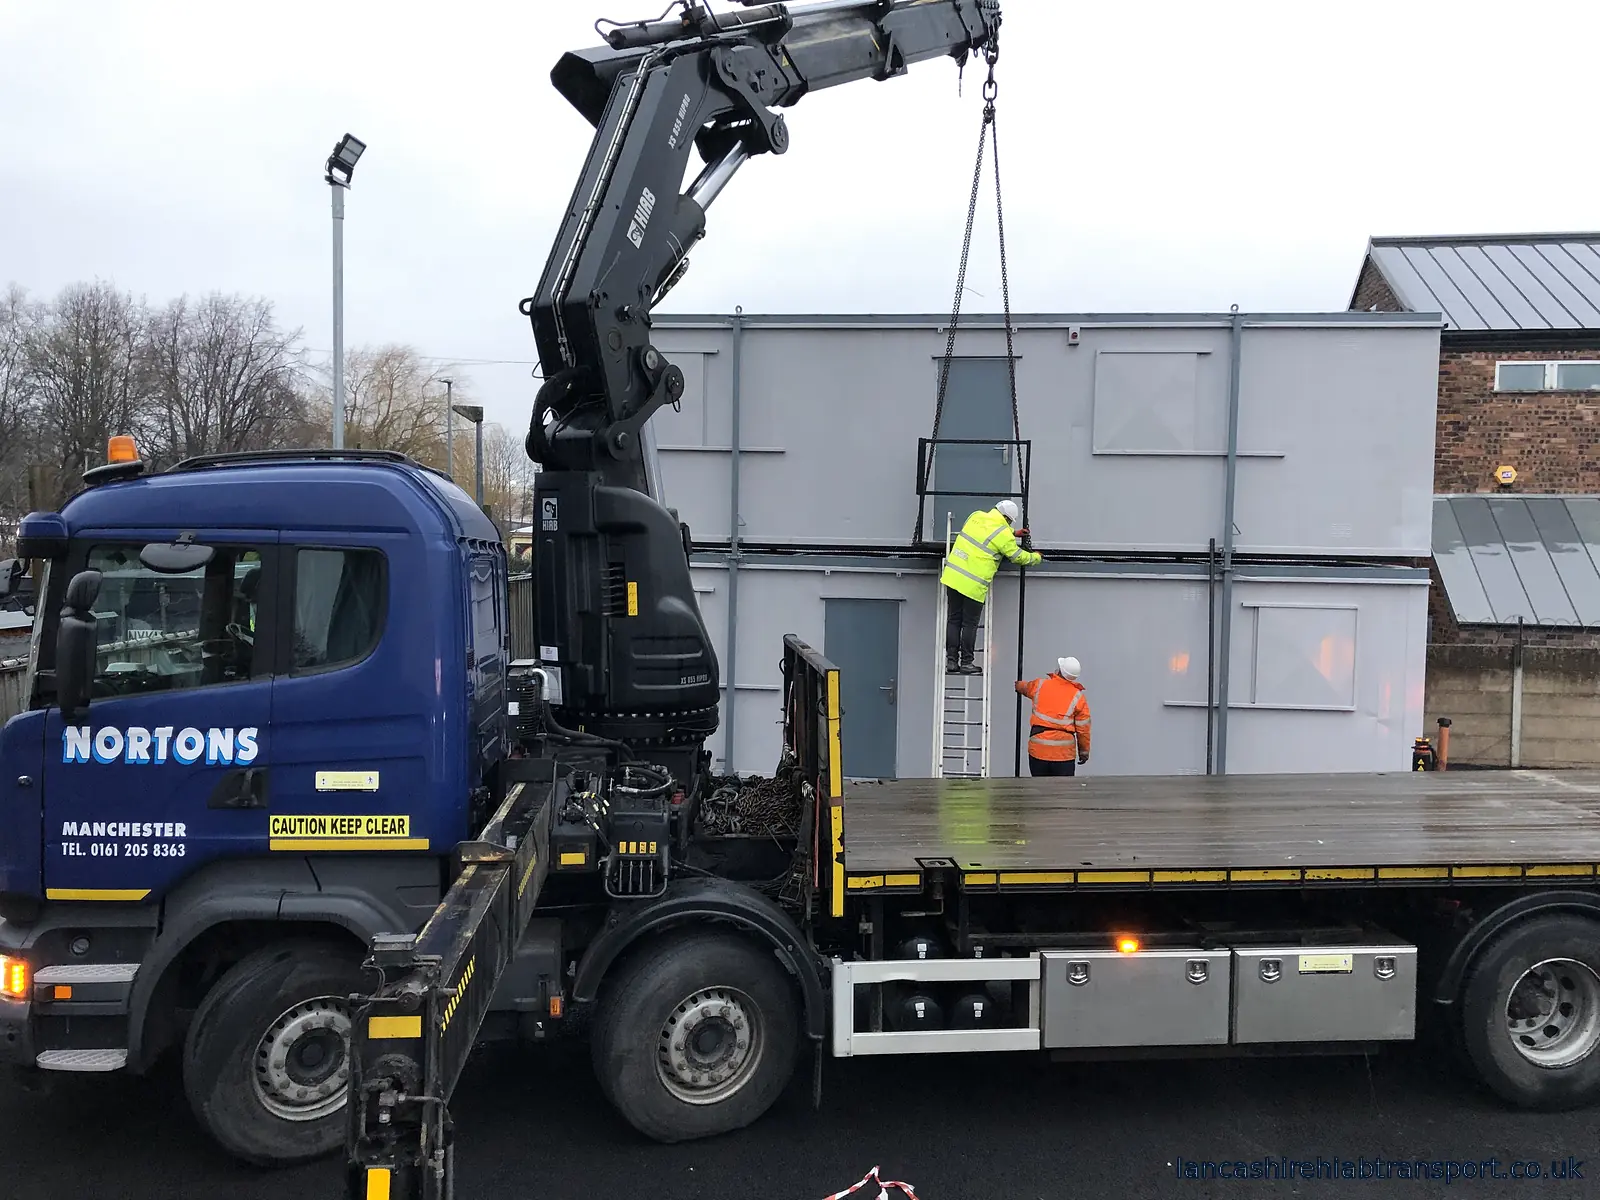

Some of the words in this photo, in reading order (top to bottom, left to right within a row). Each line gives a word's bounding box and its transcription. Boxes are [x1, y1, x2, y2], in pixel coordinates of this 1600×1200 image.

[668, 134, 677, 150] XS
[634, 186, 656, 230] HIAB
[542, 520, 558, 531] HIAB
[62, 726, 259, 765] NORTONS
[62, 821, 187, 837] MANCHESTER
[272, 817, 327, 835] CAUTION
[330, 817, 362, 835] KEEP
[365, 817, 406, 835] CLEAR
[62, 842, 87, 856] TEL.
[91, 843, 118, 857] 0161
[124, 843, 148, 857] 205
[153, 843, 186, 857] 8363
